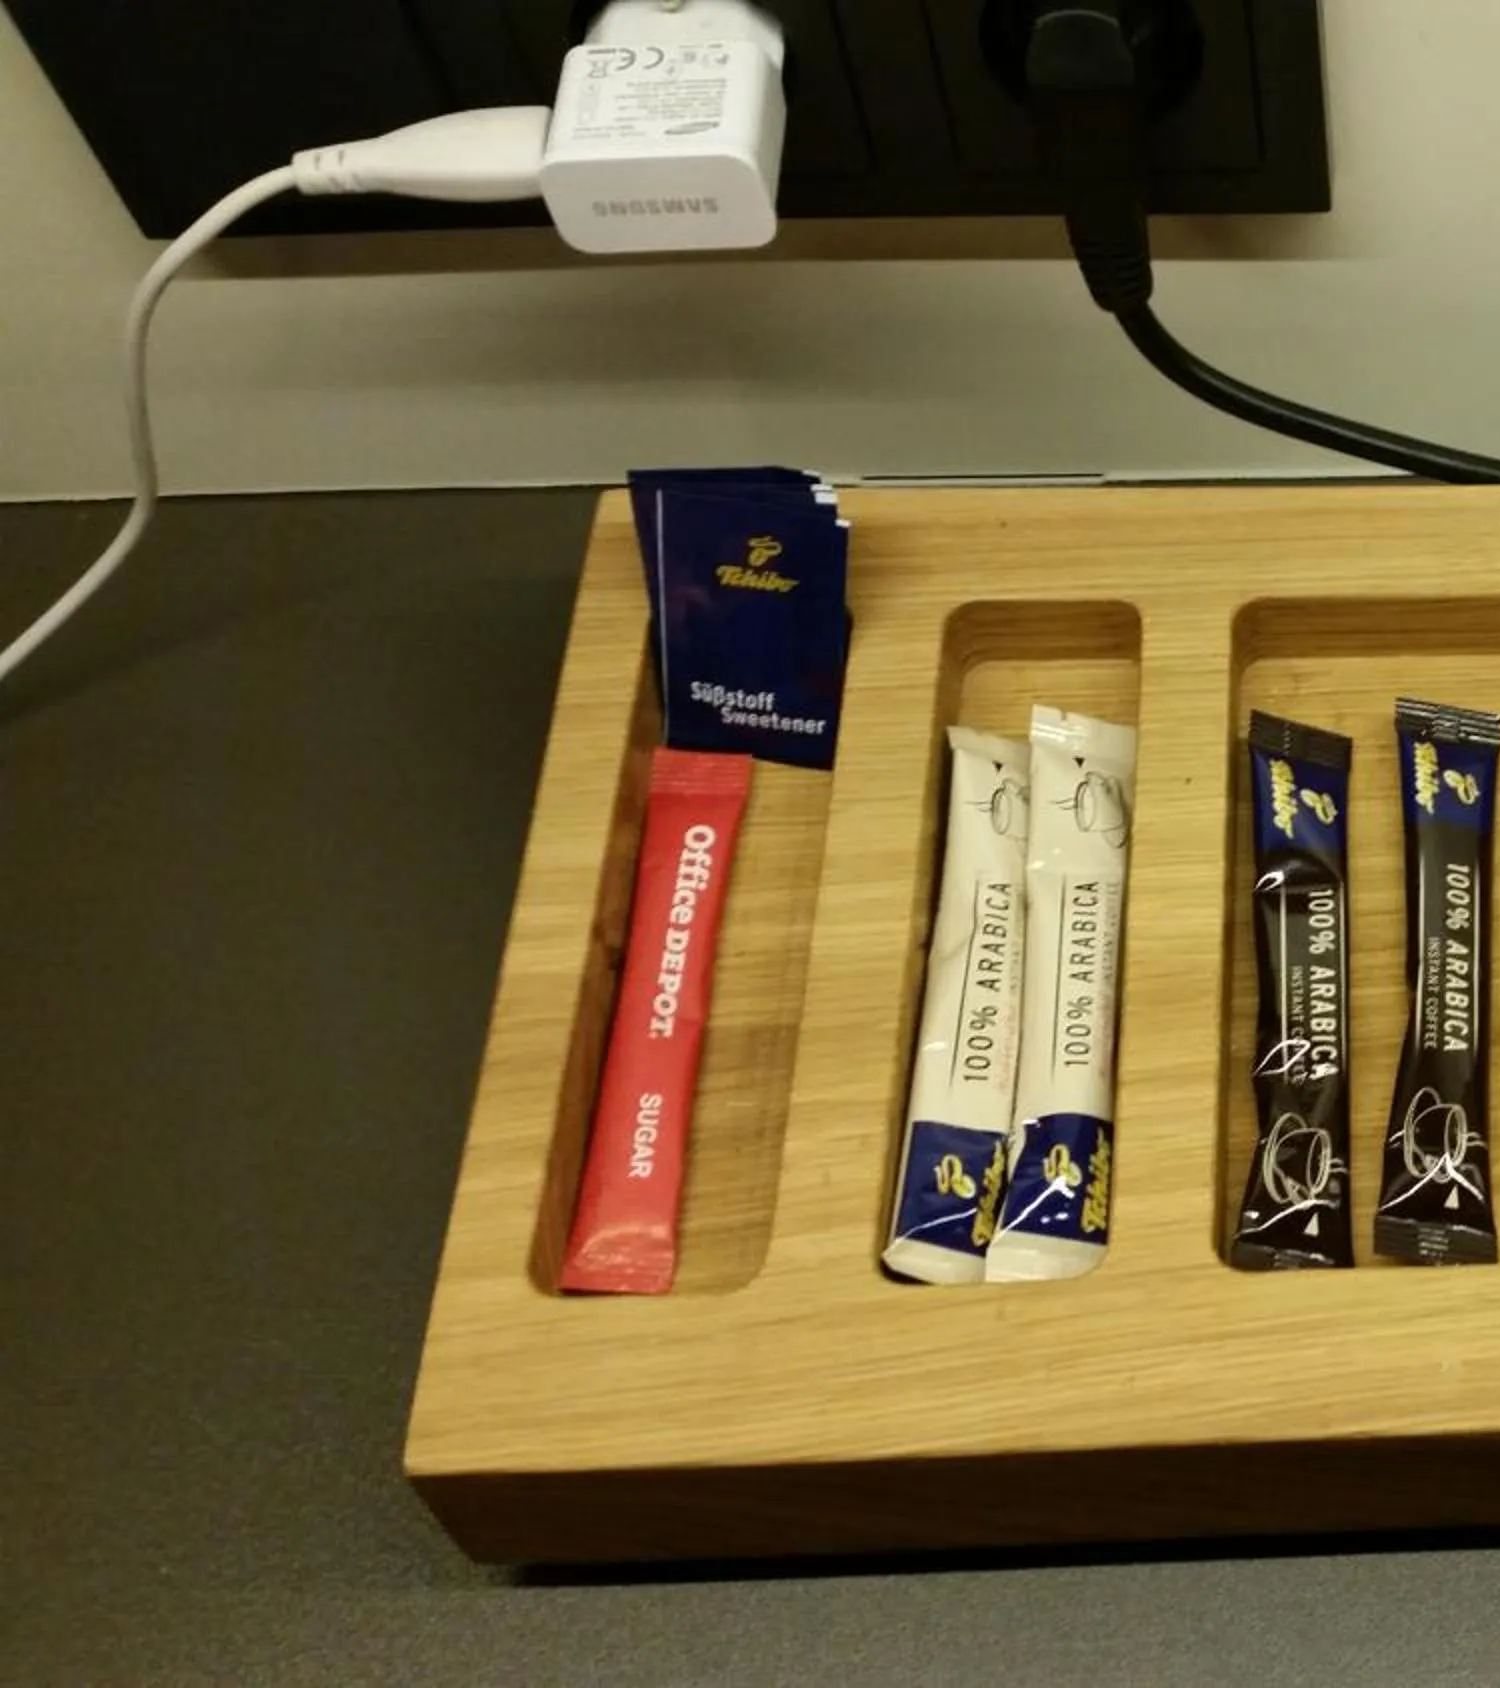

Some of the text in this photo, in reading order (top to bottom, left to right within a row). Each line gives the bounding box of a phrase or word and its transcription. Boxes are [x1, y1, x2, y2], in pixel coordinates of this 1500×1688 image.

[591, 197, 719, 217] SAMSUNG
[715, 565, 800, 593] Tchibo
[690, 680, 776, 711] Süßstoff
[720, 706, 827, 735] Sweetener
[1268, 758, 1299, 839] Tchibo
[1413, 741, 1442, 816] Tchibo
[669, 824, 716, 925] Office
[975, 881, 1013, 993] ARABICA
[1063, 881, 1099, 1069] 100% ARABICA
[1442, 863, 1470, 1052] 100% ARABICA
[1291, 965, 1306, 1022] INSTANT
[1309, 888, 1338, 1081] 100% ARABICA
[1424, 936, 1440, 1051] INSTANT COFFEE
[962, 1005, 999, 1083] 100%
[627, 1092, 663, 1180] SUGAR
